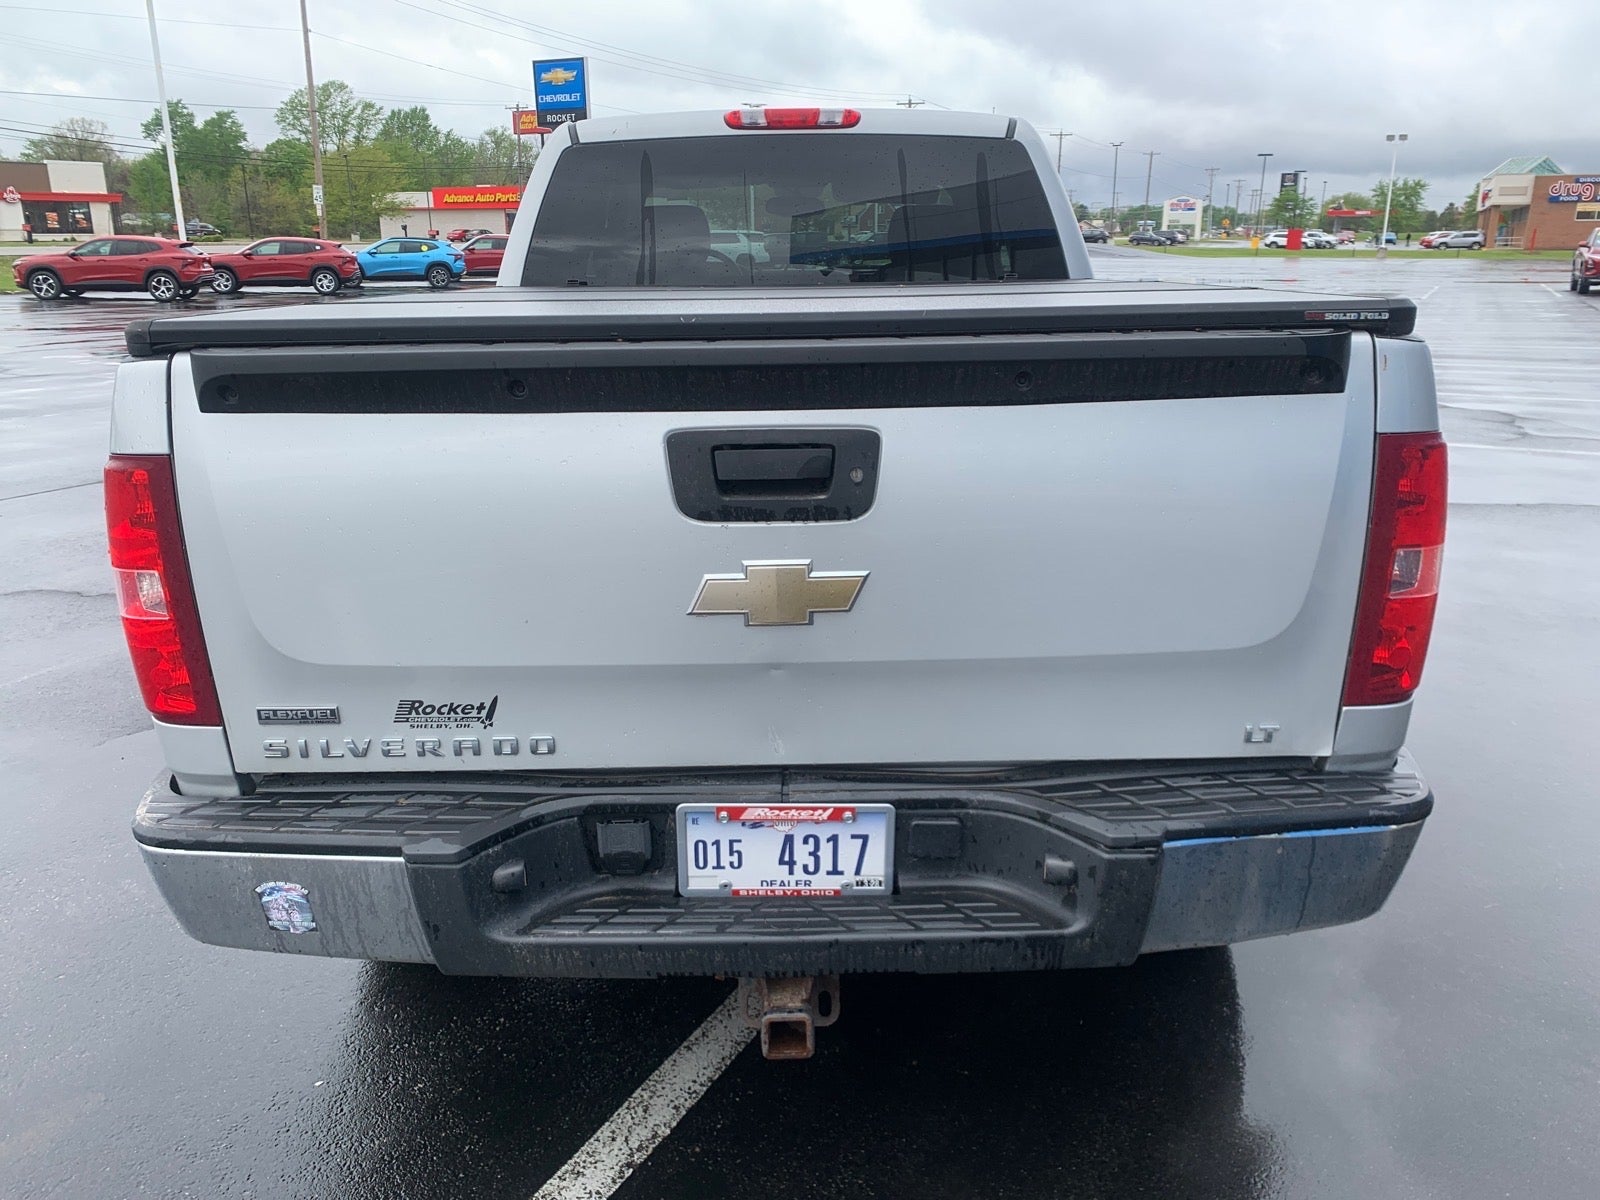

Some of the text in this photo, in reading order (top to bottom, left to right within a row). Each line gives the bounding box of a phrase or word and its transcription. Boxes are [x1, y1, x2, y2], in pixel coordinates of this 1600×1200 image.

[538, 93, 581, 103] CHEVROLET
[546, 113, 576, 123] ROCKET
[1549, 180, 1595, 201] drug
[443, 193, 475, 203] Advance
[475, 193, 495, 202] Auto
[495, 192, 516, 202] Parts
[1324, 312, 1359, 320] SOLID
[1360, 311, 1390, 320] FOLD
[400, 699, 486, 716] Rocket
[259, 709, 336, 720] FLEXFUEL
[1243, 724, 1280, 744] LT
[262, 734, 557, 759] SILVERADO
[693, 833, 870, 876] 015 4317
[760, 879, 813, 888] DEALER
[801, 888, 835, 896] OHIO
